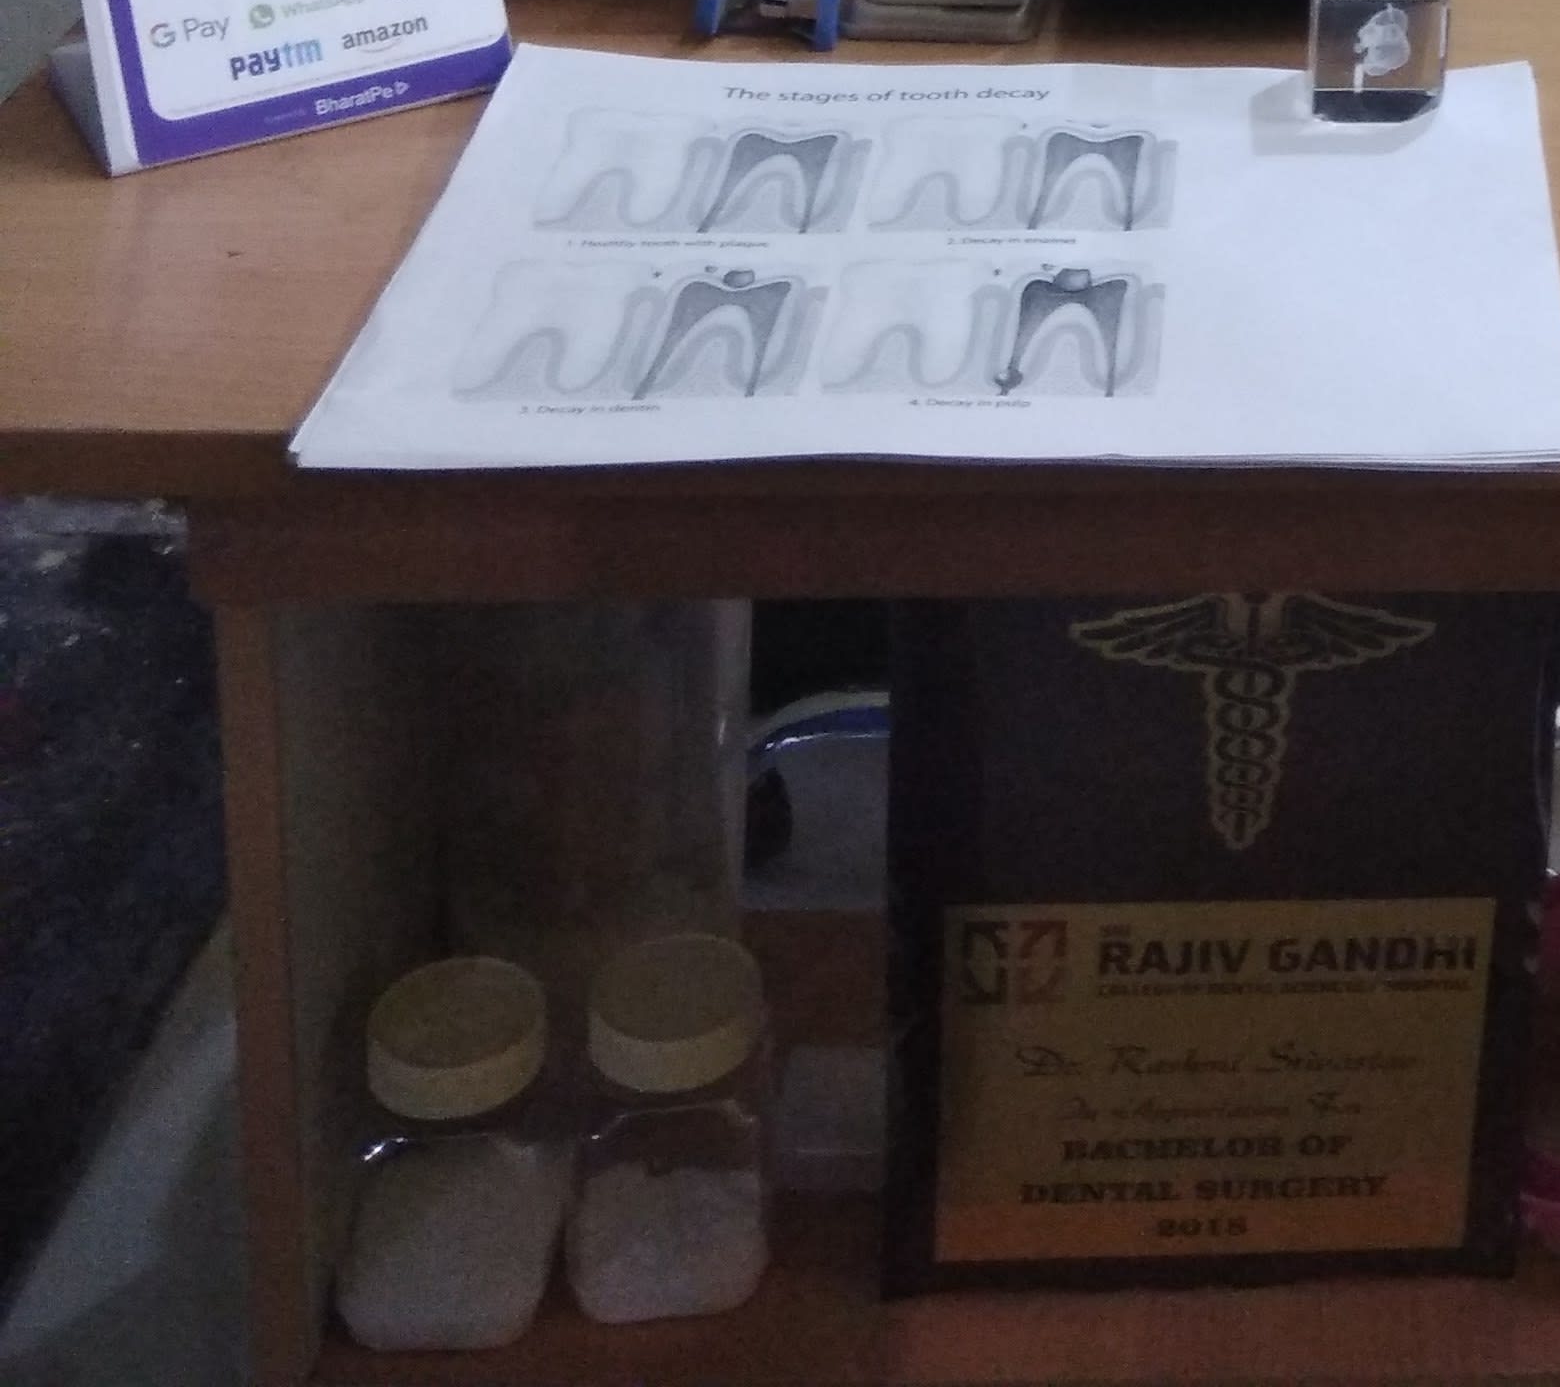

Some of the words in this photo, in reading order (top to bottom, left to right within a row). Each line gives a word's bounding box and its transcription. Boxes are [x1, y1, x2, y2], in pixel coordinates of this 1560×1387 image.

[149, 23, 176, 49] G
[183, 16, 231, 43] Pay
[342, 15, 429, 50] amazon
[230, 38, 323, 80] paytm
[314, 85, 395, 115] BharatPe
[722, 86, 771, 101] The
[777, 88, 859, 105] stages
[866, 88, 893, 102] of
[899, 88, 969, 102] tooth
[975, 87, 1051, 102] decay
[926, 397, 972, 409] Decay
[1099, 938, 1250, 974] RAJIV
[1268, 935, 1477, 972] GANDHI
[1062, 1135, 1282, 1161] BACHELOR
[1296, 1134, 1353, 1158] OF
[1020, 1180, 1183, 1205] DENTAL
[1193, 1175, 1387, 1202] SURGERY
